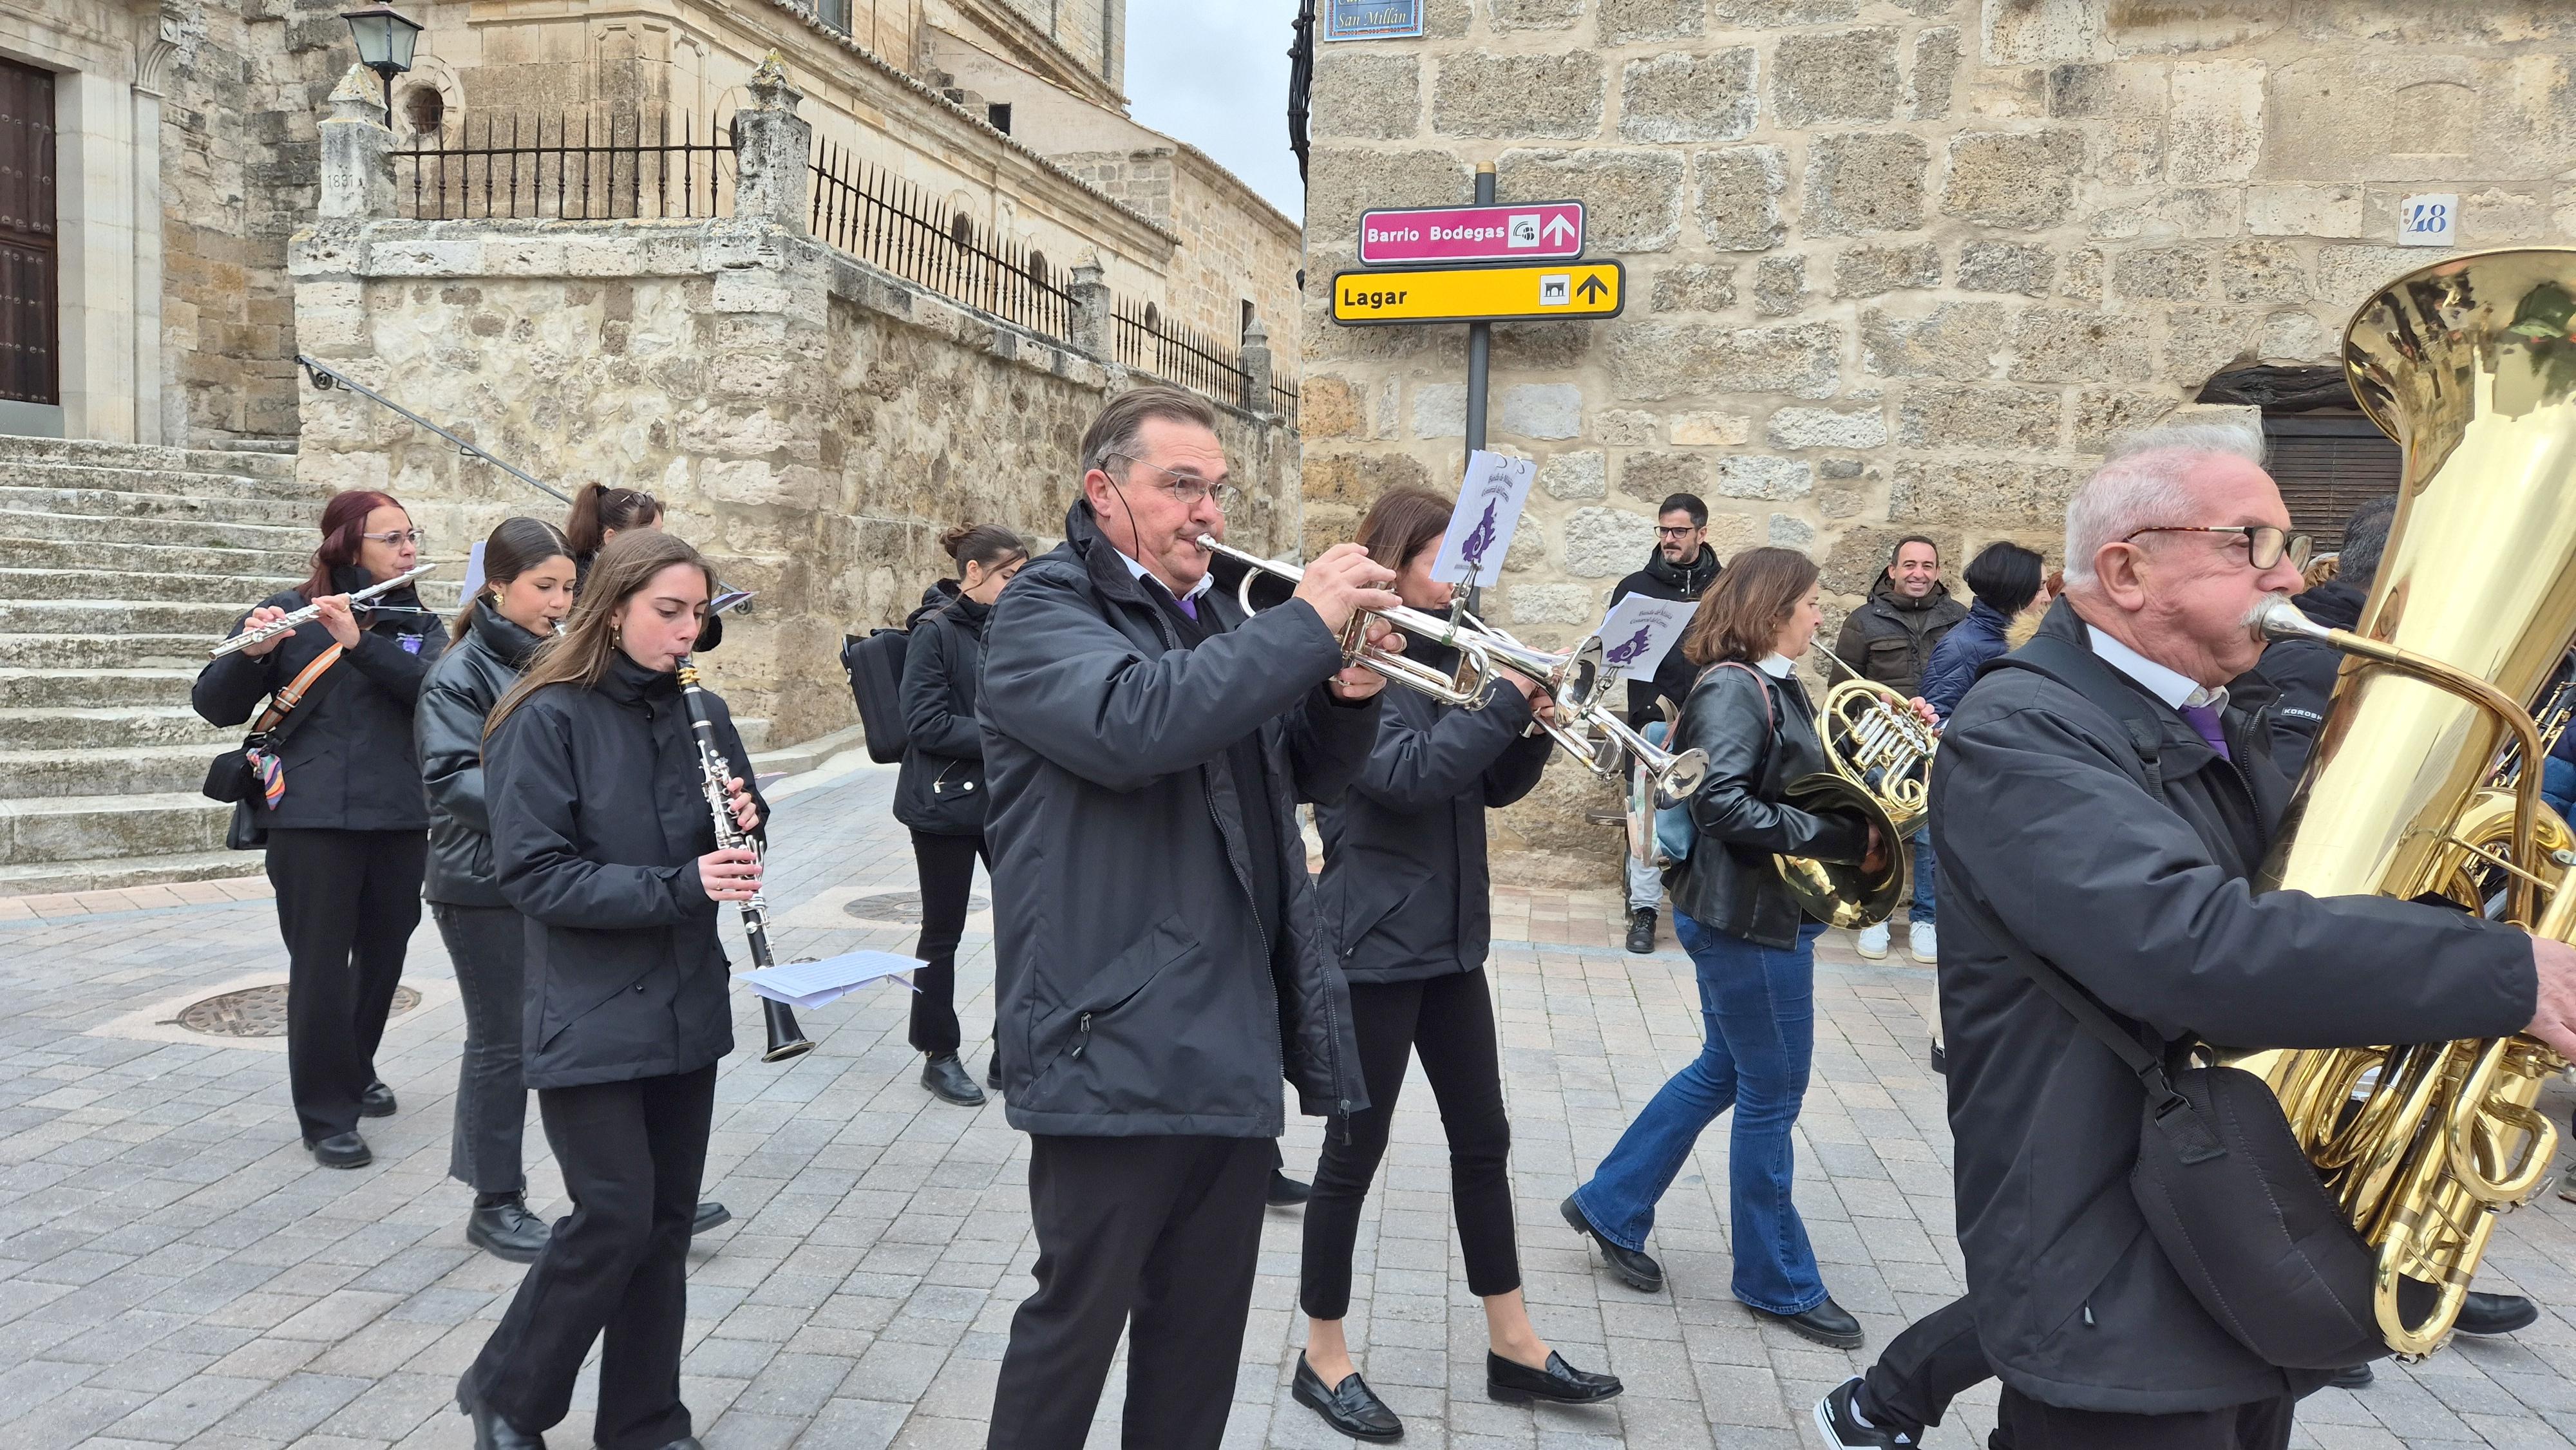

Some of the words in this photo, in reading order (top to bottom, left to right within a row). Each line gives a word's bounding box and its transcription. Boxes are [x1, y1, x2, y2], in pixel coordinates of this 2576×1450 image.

[1336, 13, 1360, 28] San
[1363, 8, 1406, 26] Millán
[2407, 204, 2446, 233] 48
[1368, 227, 1419, 243] Barrio
[1430, 225, 1505, 241] Bodegas
[1344, 288, 1407, 309] Lagar
